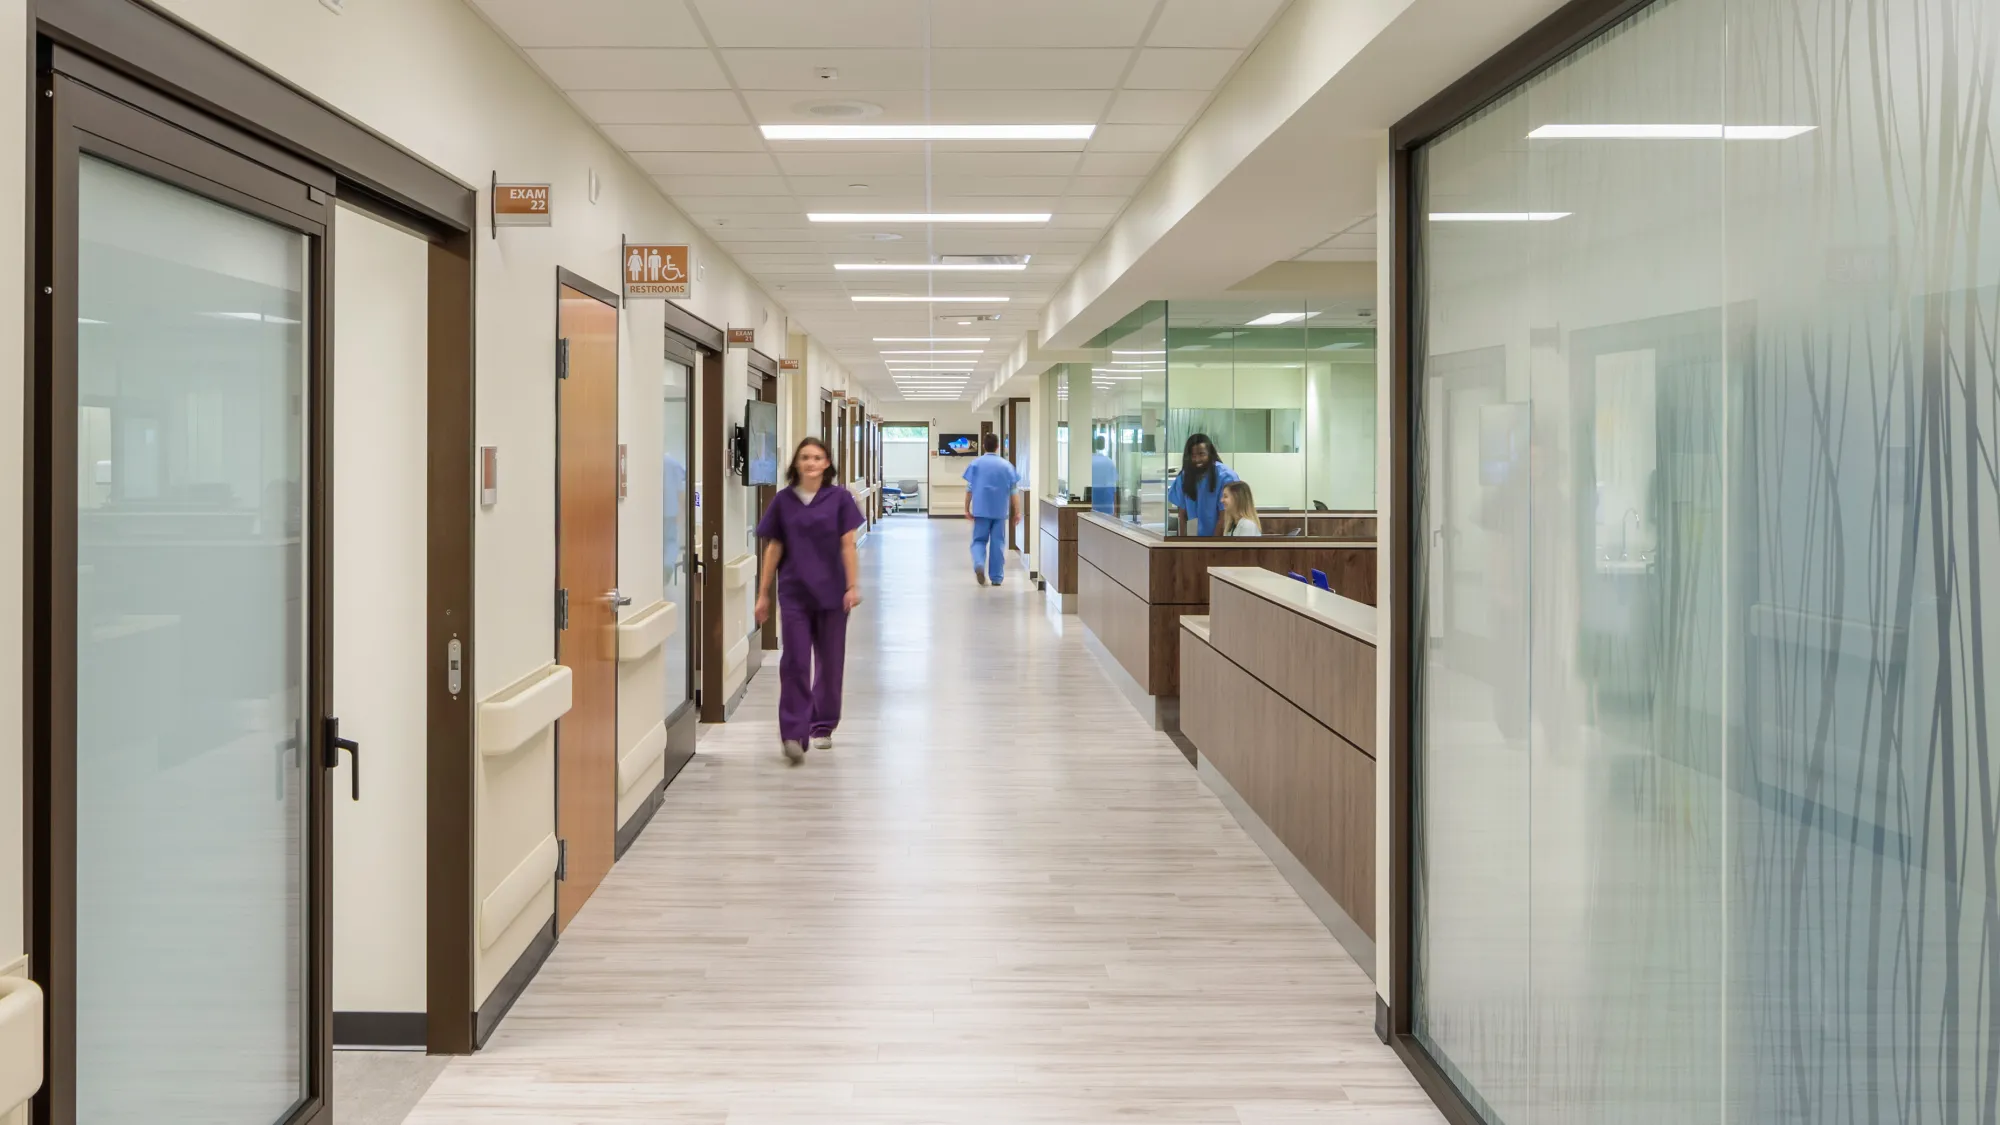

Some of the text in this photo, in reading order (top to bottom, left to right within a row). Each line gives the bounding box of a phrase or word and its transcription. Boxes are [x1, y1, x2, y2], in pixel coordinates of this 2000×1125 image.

[510, 189, 546, 199] EXAM
[530, 200, 546, 210] 22
[630, 285, 685, 293] RESTROOMS
